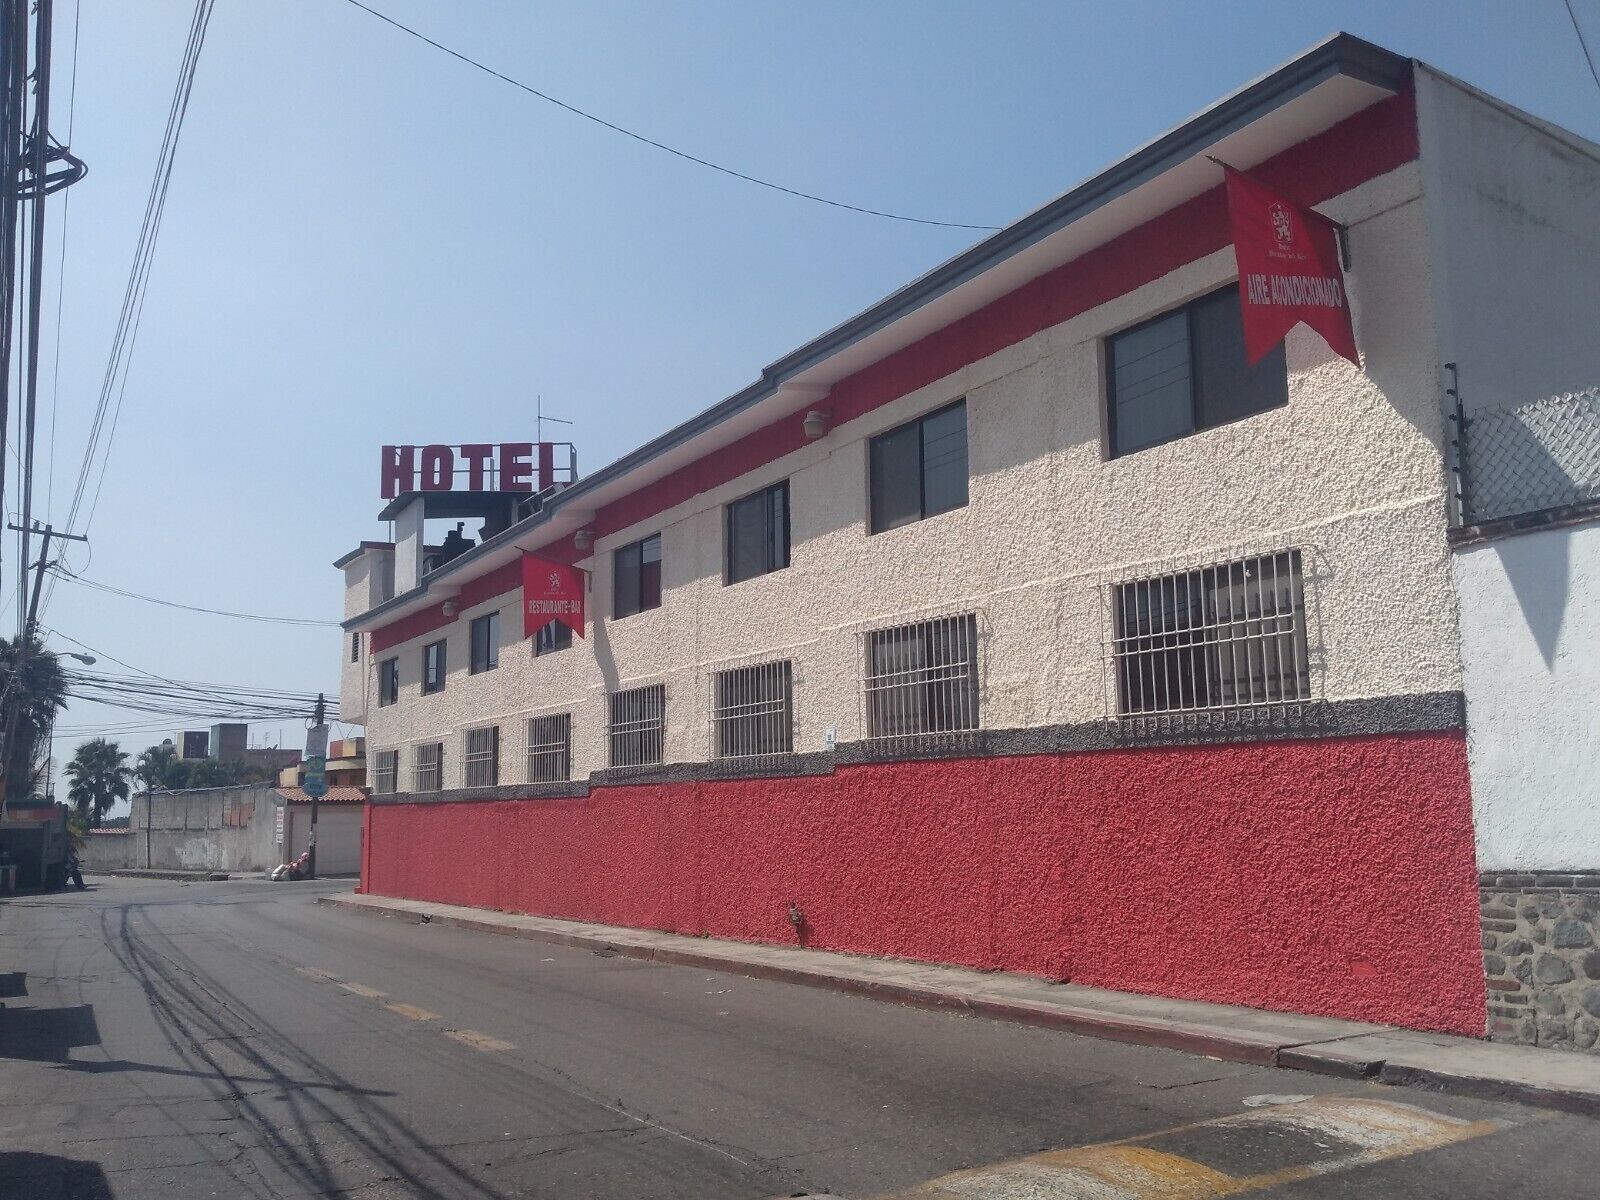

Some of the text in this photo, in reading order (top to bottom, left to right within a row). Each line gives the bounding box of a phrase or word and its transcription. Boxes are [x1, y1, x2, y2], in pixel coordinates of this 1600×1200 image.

[1247, 274, 1342, 307] AIRE ACONDICIONADO
[381, 442, 573, 499] HOTEL
